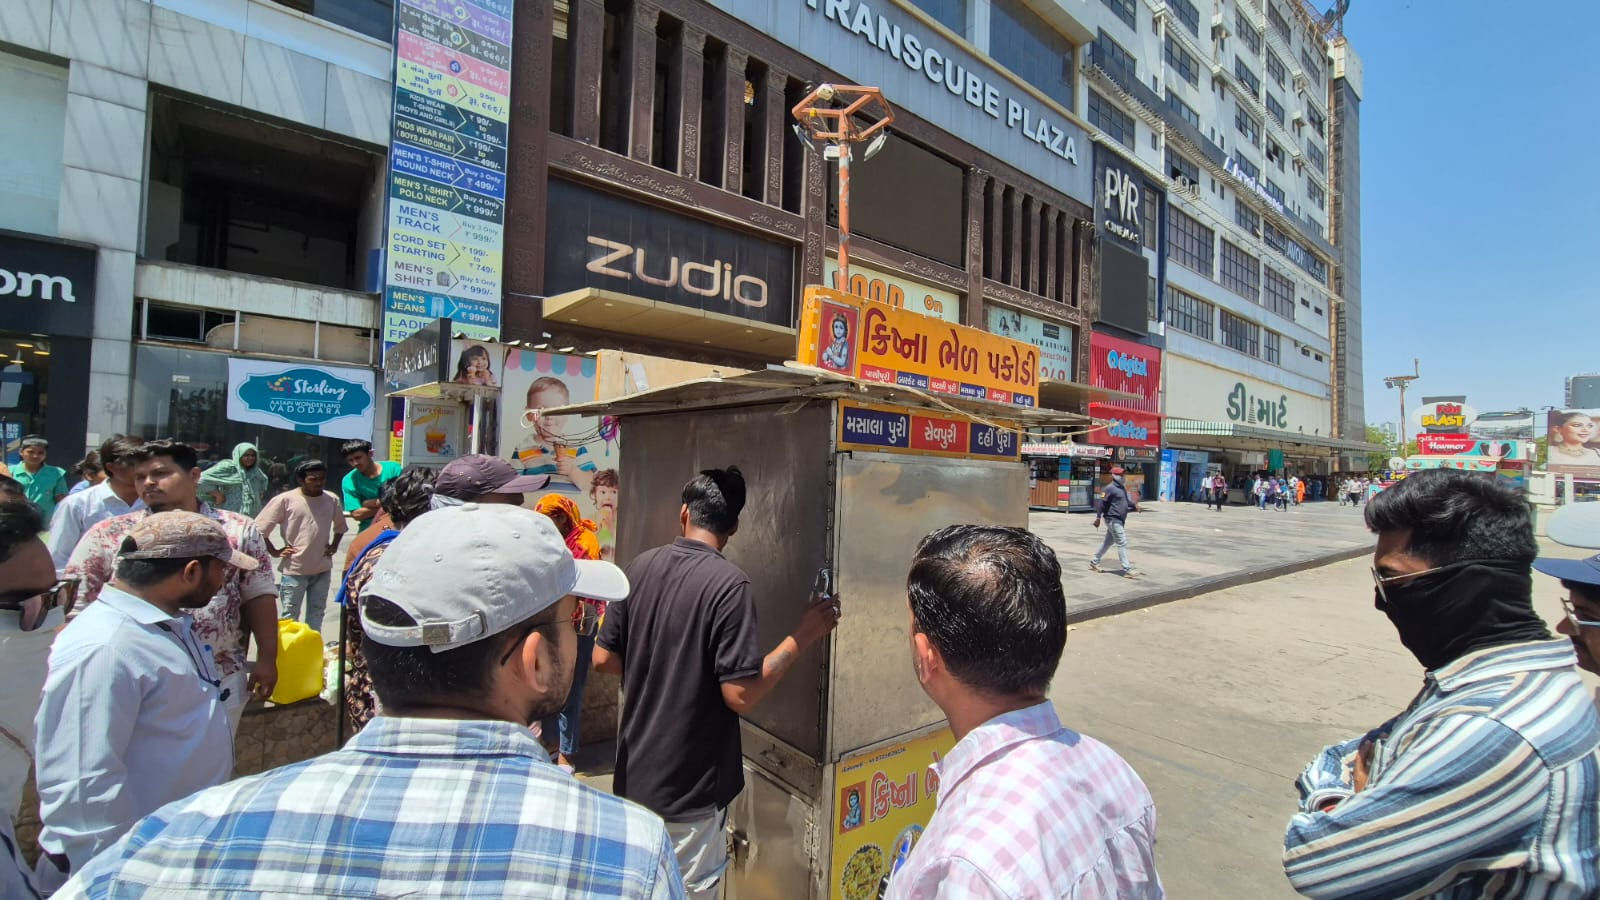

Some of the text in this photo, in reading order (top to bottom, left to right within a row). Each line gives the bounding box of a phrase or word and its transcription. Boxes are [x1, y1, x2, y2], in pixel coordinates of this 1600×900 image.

[805, 0, 1078, 166] RANSCUBE PLAZA
[409, 93, 446, 110] KIDS WEAR
[413, 101, 442, 116] T-SHIRTS
[419, 111, 433, 120] AND
[397, 119, 455, 143] KIDS WEAR PAIR
[400, 130, 418, 141] BOYS
[419, 137, 433, 146] AND
[433, 141, 452, 152] GIRLS
[394, 148, 456, 171] MEN'S T-SHIRT
[480, 158, 502, 169] 499/-
[396, 158, 454, 180] ROUND NECK
[464, 168, 478, 177] Buy
[485, 174, 501, 184] Only
[394, 176, 454, 199] MEN'S T-SHIRT
[474, 180, 498, 192] 499/-
[399, 188, 448, 207] POLO NECK
[463, 194, 477, 203] Buy
[484, 200, 500, 209] Only
[1104, 167, 1139, 225] PVR
[399, 205, 439, 221] MEN'S
[473, 205, 497, 217] 999/-
[396, 216, 440, 234] TRACK
[462, 221, 476, 230] Buy
[483, 226, 498, 236] Only
[1105, 220, 1139, 244] CINEMAS
[393, 232, 447, 251] CORD SET
[472, 232, 496, 244] 999/-
[393, 244, 446, 261] STARTING
[469, 247, 489, 257] 199/-
[394, 261, 433, 275] MEN'S
[476, 265, 496, 274] 749/-
[394, 273, 433, 287] SHIRT
[460, 274, 473, 283] Buy
[481, 279, 496, 288] Only
[392, 291, 425, 304] MEN'S
[470, 286, 493, 296] 999/-
[391, 302, 426, 314] JEANS
[458, 302, 472, 311] Buy
[480, 305, 496, 314] Only
[924, 294, 944, 314] On
[469, 313, 493, 323] 999/-
[862, 307, 1036, 387] ક્રિષ્ના ભેળ પકોડી
[293, 379, 348, 400] Sterling
[269, 404, 341, 416] VADODARA
[1226, 382, 1288, 429] ડી માર્ટ
[1421, 414, 1466, 427] BLAST
[846, 415, 906, 444] મસાલા પુરી
[924, 420, 956, 449] સેવપુરી
[978, 427, 994, 446] દહીં
[996, 430, 1011, 453] પુરી
